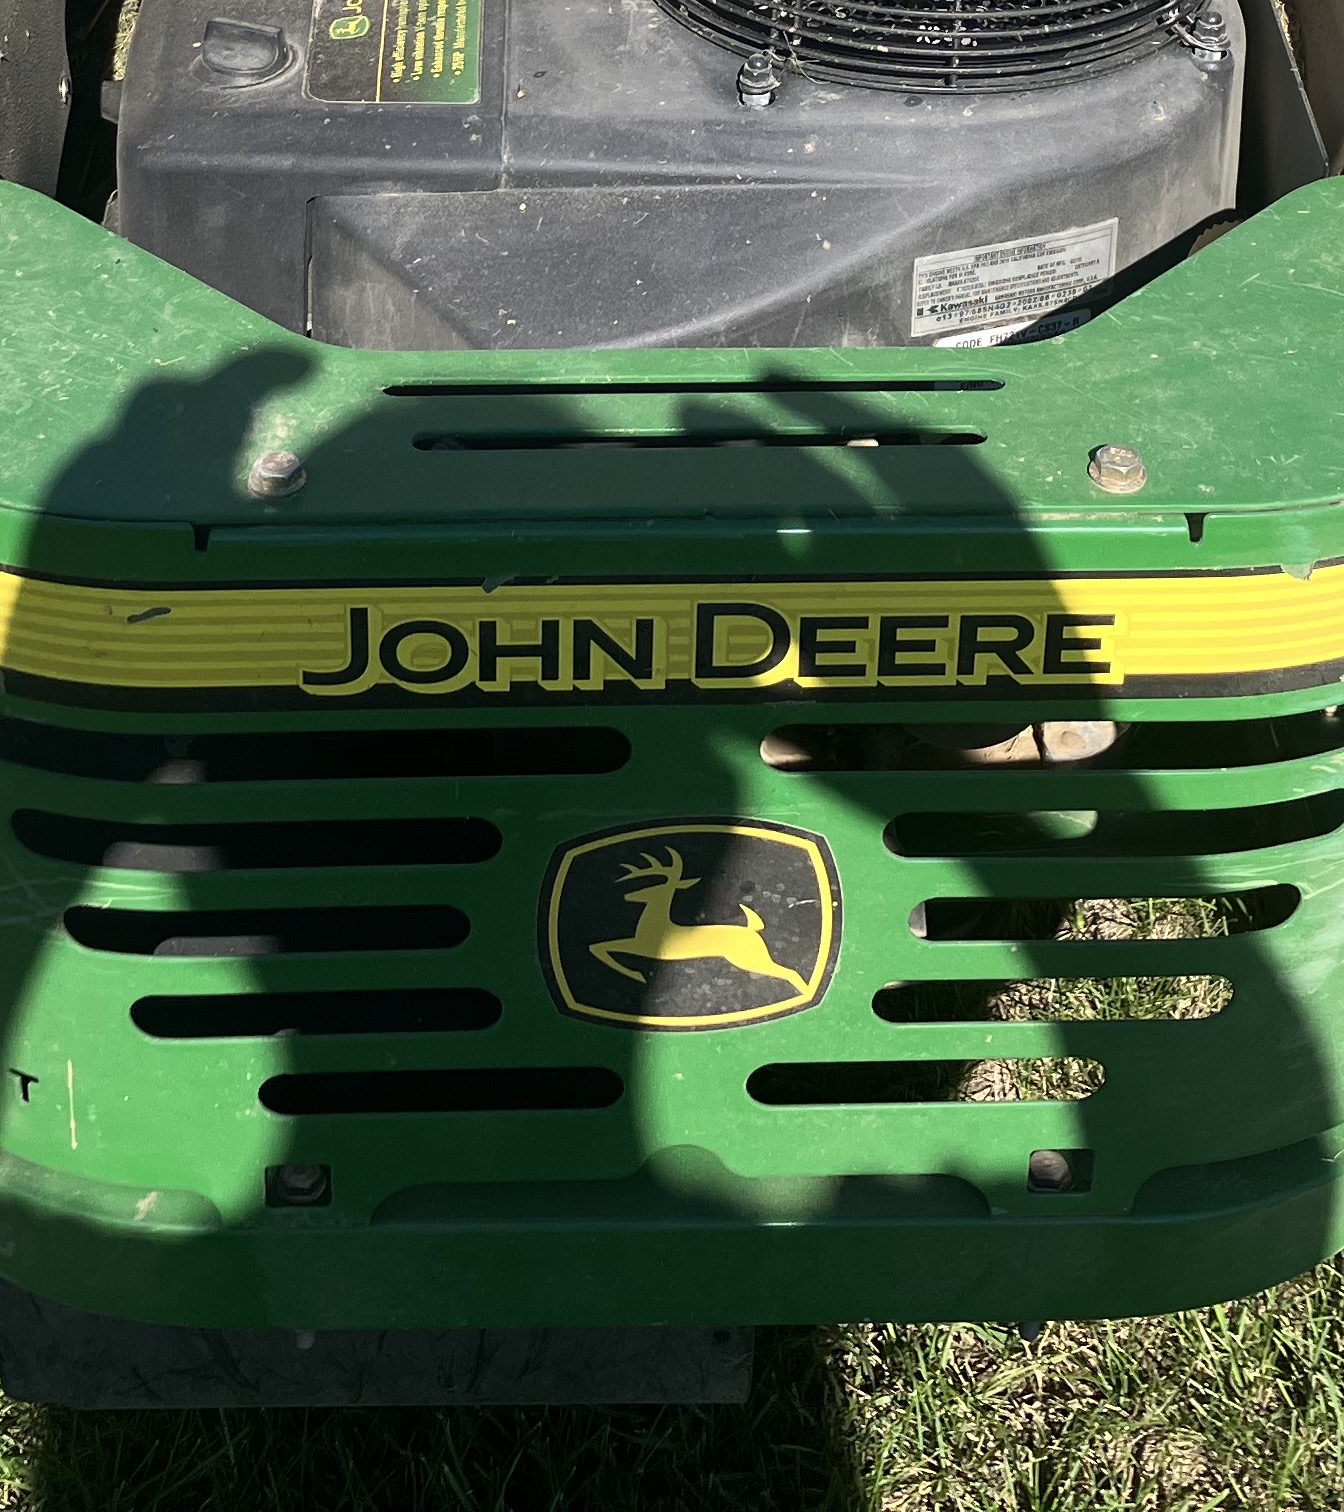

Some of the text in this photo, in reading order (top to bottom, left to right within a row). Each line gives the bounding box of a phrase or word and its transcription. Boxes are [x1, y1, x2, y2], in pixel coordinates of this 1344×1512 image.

[940, 294, 987, 312] Kawasaki
[302, 601, 1119, 689] JOHN DEERE
